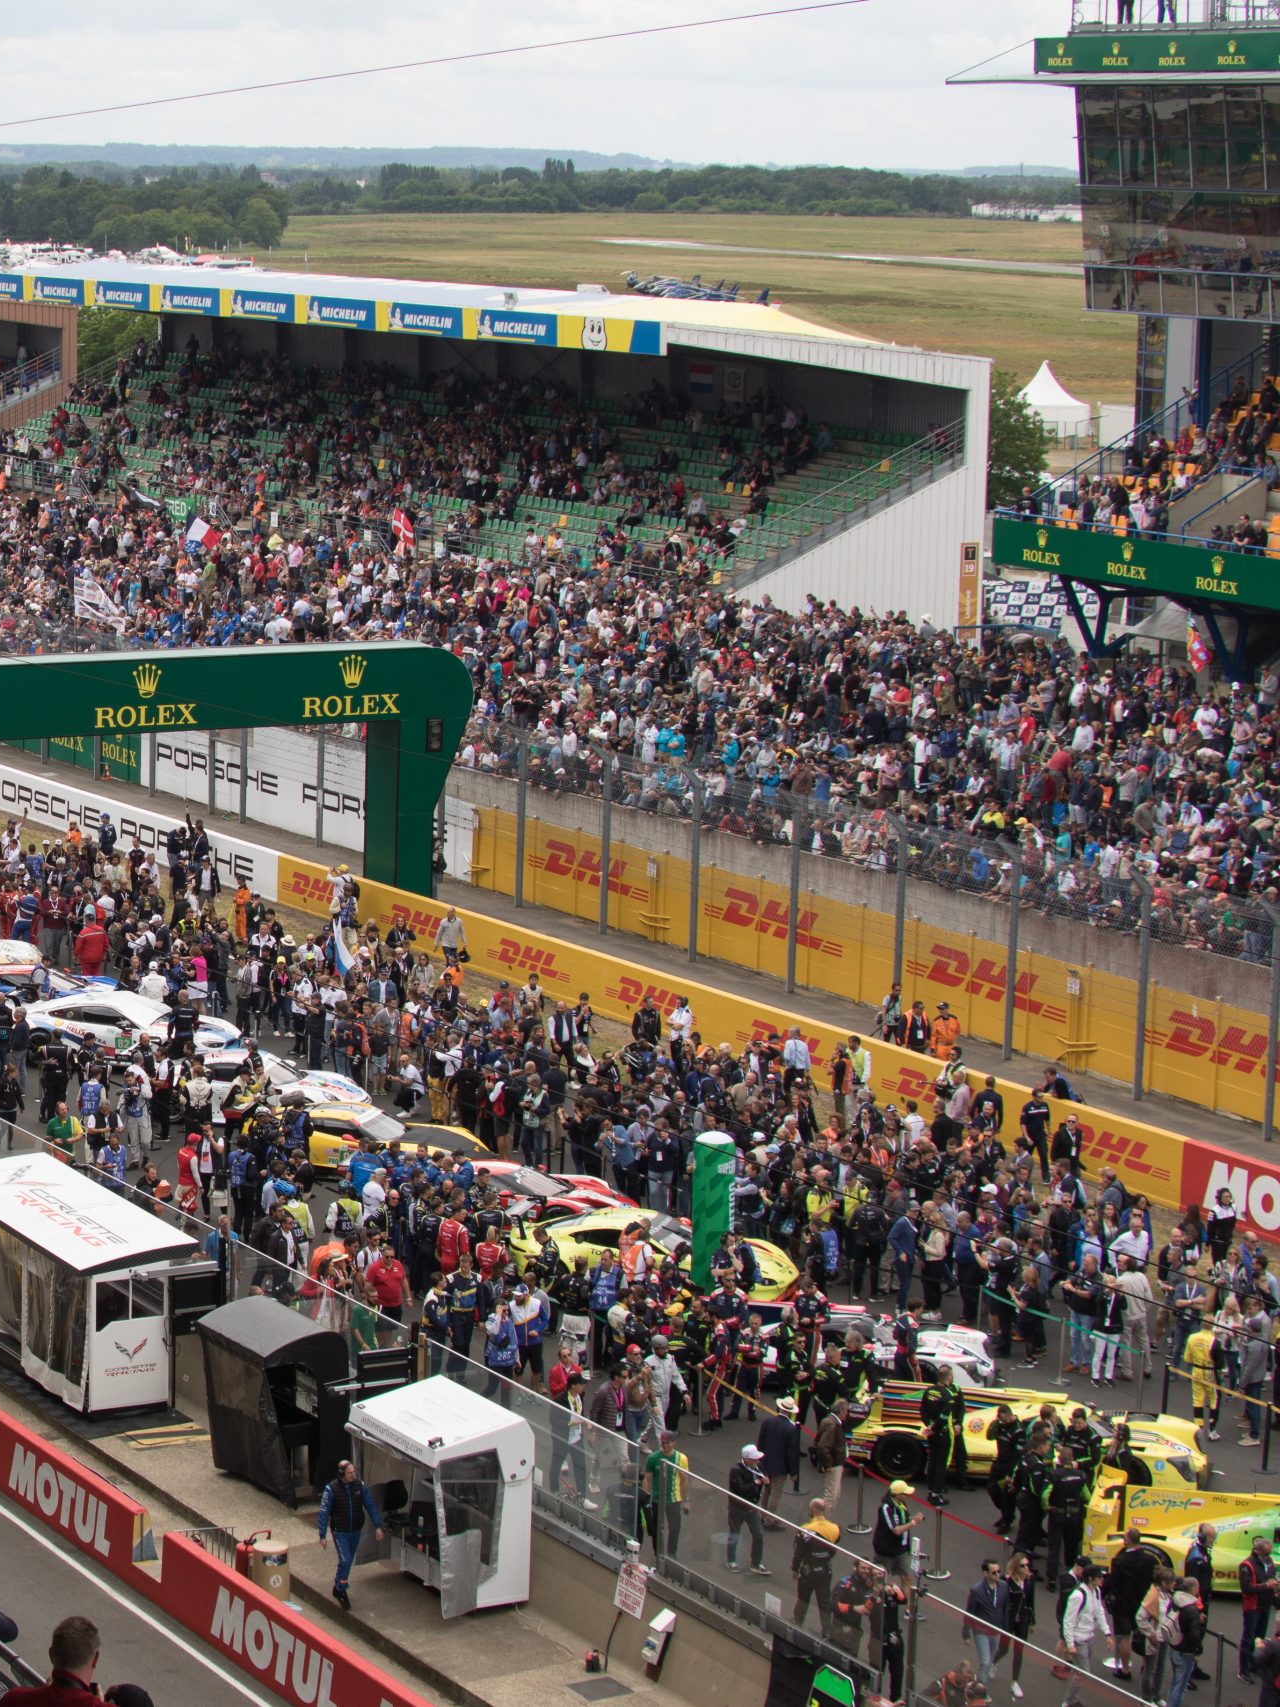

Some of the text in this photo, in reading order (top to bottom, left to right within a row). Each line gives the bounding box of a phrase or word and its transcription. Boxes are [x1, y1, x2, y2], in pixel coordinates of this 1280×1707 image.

[1048, 57, 1073, 66] ROLEX
[1102, 56, 1128, 66] ROLEX
[1158, 56, 1185, 66] ROLEX
[1217, 55, 1246, 65] ROLEX
[43, 285, 77, 298] MICHELIN
[105, 289, 142, 303] MICHELIN
[172, 295, 212, 308] MICHELIN
[244, 300, 286, 314] MICHELIN
[321, 306, 366, 321] MICHELIN
[404, 313, 452, 329] MICHELIN
[493, 320, 546, 337] MICHELIN
[1023, 548, 1061, 566] ROLEX
[965, 564, 974, 573] 19
[1107, 562, 1146, 580] ROLEX
[1195, 576, 1238, 595] ROLEX
[302, 693, 400, 718] ROLEX
[94, 703, 198, 728] ROLEX
[102, 741, 136, 767] ROLEX
[543, 839, 632, 897] DHL
[390, 903, 443, 940] DHL
[722, 887, 824, 950] DHL
[498, 938, 558, 979] DHL
[926, 943, 1047, 1016] DHL
[83, 1101, 96, 1109] 367
[14, 1190, 108, 1247] RACING
[29, 1188, 129, 1244] CORVETTE
[104, 1368, 157, 1377] RACING
[105, 1362, 157, 1372] CORVETTE
[360, 1415, 423, 1457] astonmartinracing.com
[9, 1443, 111, 1557] MOTUL
[1128, 1488, 1192, 1513] Europol
[210, 1585, 338, 1707] MOTUL
